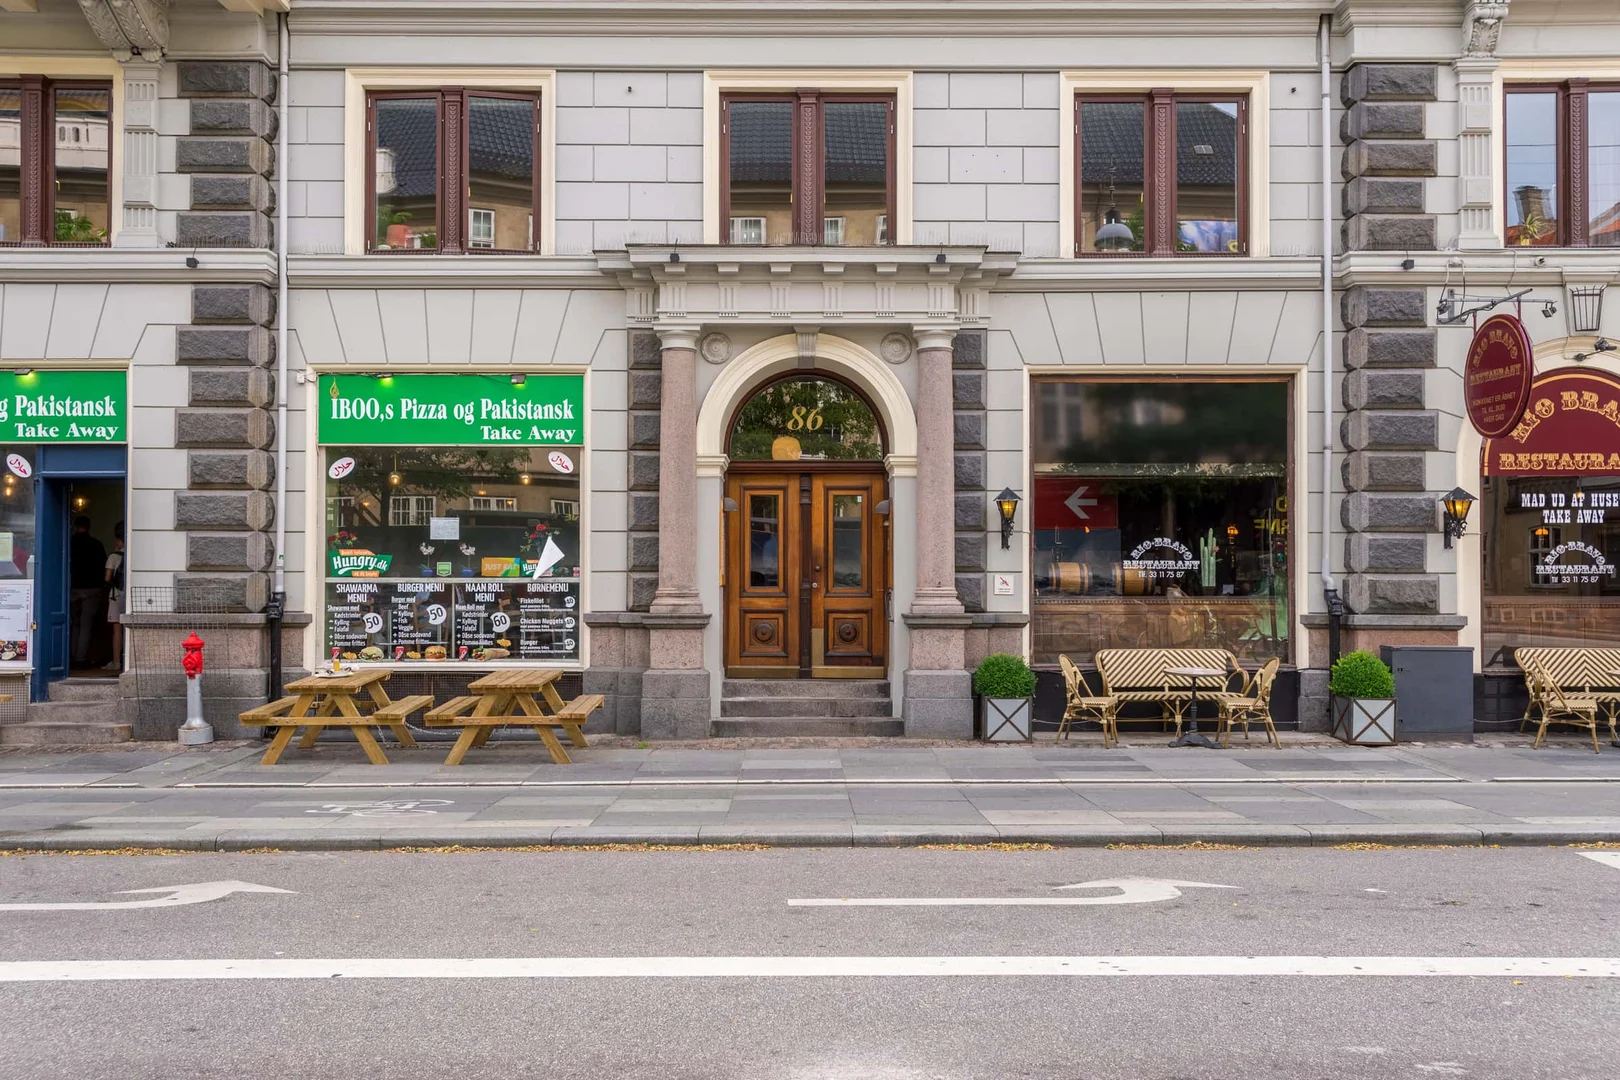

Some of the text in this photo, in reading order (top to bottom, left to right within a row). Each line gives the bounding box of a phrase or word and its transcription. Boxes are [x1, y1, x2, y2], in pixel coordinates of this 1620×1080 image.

[1473, 329, 1518, 367] RIO BRAVO
[15, 395, 116, 416] Pakistansk
[400, 398, 447, 419] Pizza
[454, 402, 474, 424] og
[480, 399, 574, 420] Pakistansk
[787, 406, 823, 430] 86
[1509, 398, 1554, 444] RIO
[14, 422, 119, 440] Take Away
[480, 426, 576, 442] Take Away
[1522, 493, 1620, 507] MAD UD AF HUSE
[1543, 510, 1605, 523] TAKE AWAY
[332, 556, 387, 574] Hungry.dk
[1123, 560, 1200, 570] RESTAURANT
[1536, 565, 1614, 574] RESTAURANT
[336, 584, 378, 593] SHAWARMA
[398, 583, 444, 592] BURGER MENU
[466, 583, 504, 592] NAAN ROLL
[527, 583, 569, 592] BØRNEMENU
[347, 594, 367, 602] MENU
[475, 593, 495, 602] MENU
[430, 608, 443, 620] 50
[366, 616, 380, 629] 50
[493, 615, 506, 627] 60
